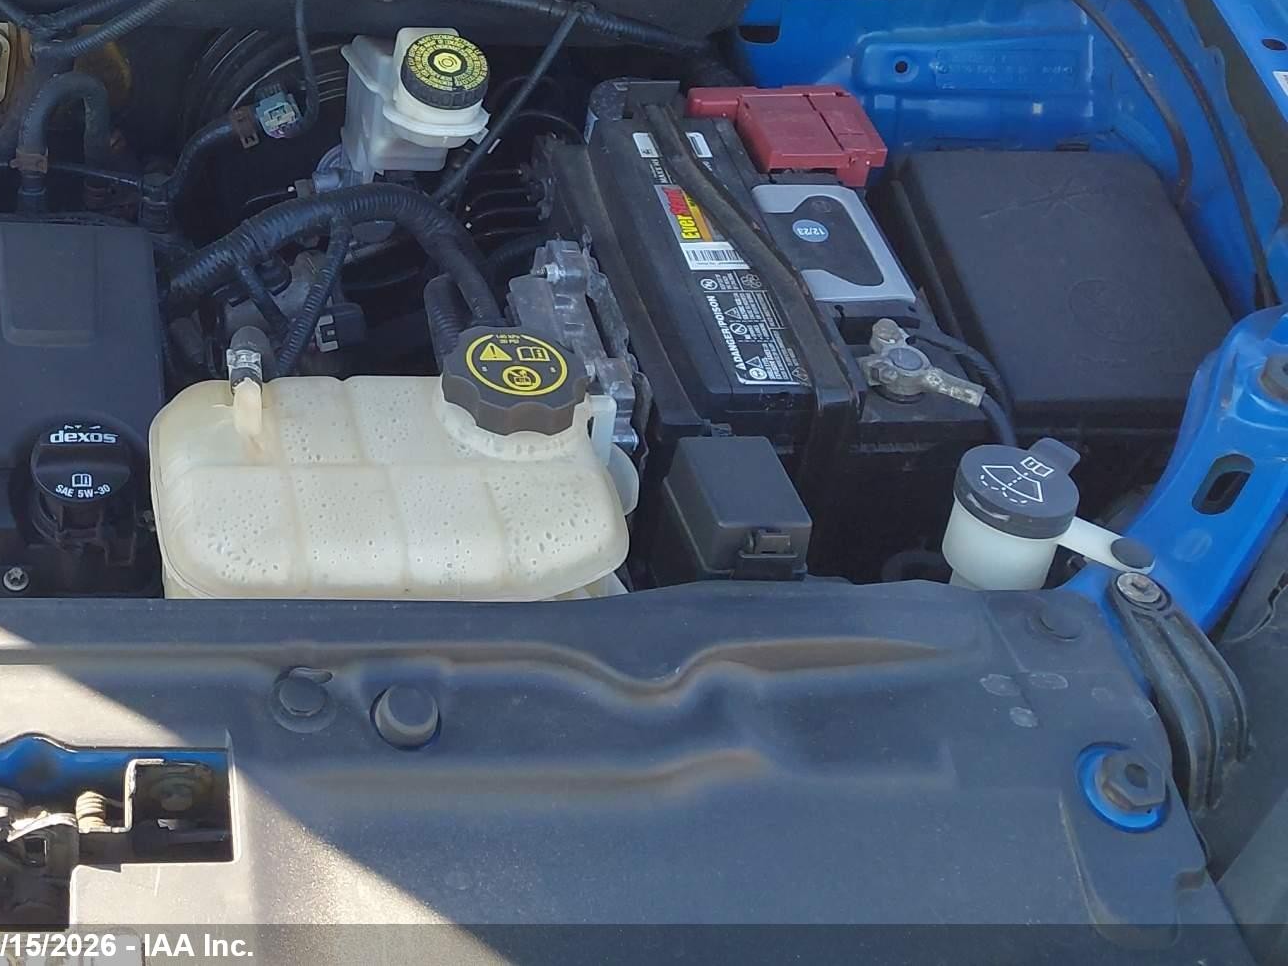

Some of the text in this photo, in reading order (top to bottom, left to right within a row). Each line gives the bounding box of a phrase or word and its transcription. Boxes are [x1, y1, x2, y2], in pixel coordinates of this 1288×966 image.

[705, 295, 744, 362] DANGER/POISON
[49, 429, 118, 444] dexos
[55, 484, 111, 499] SAE 5W-30
